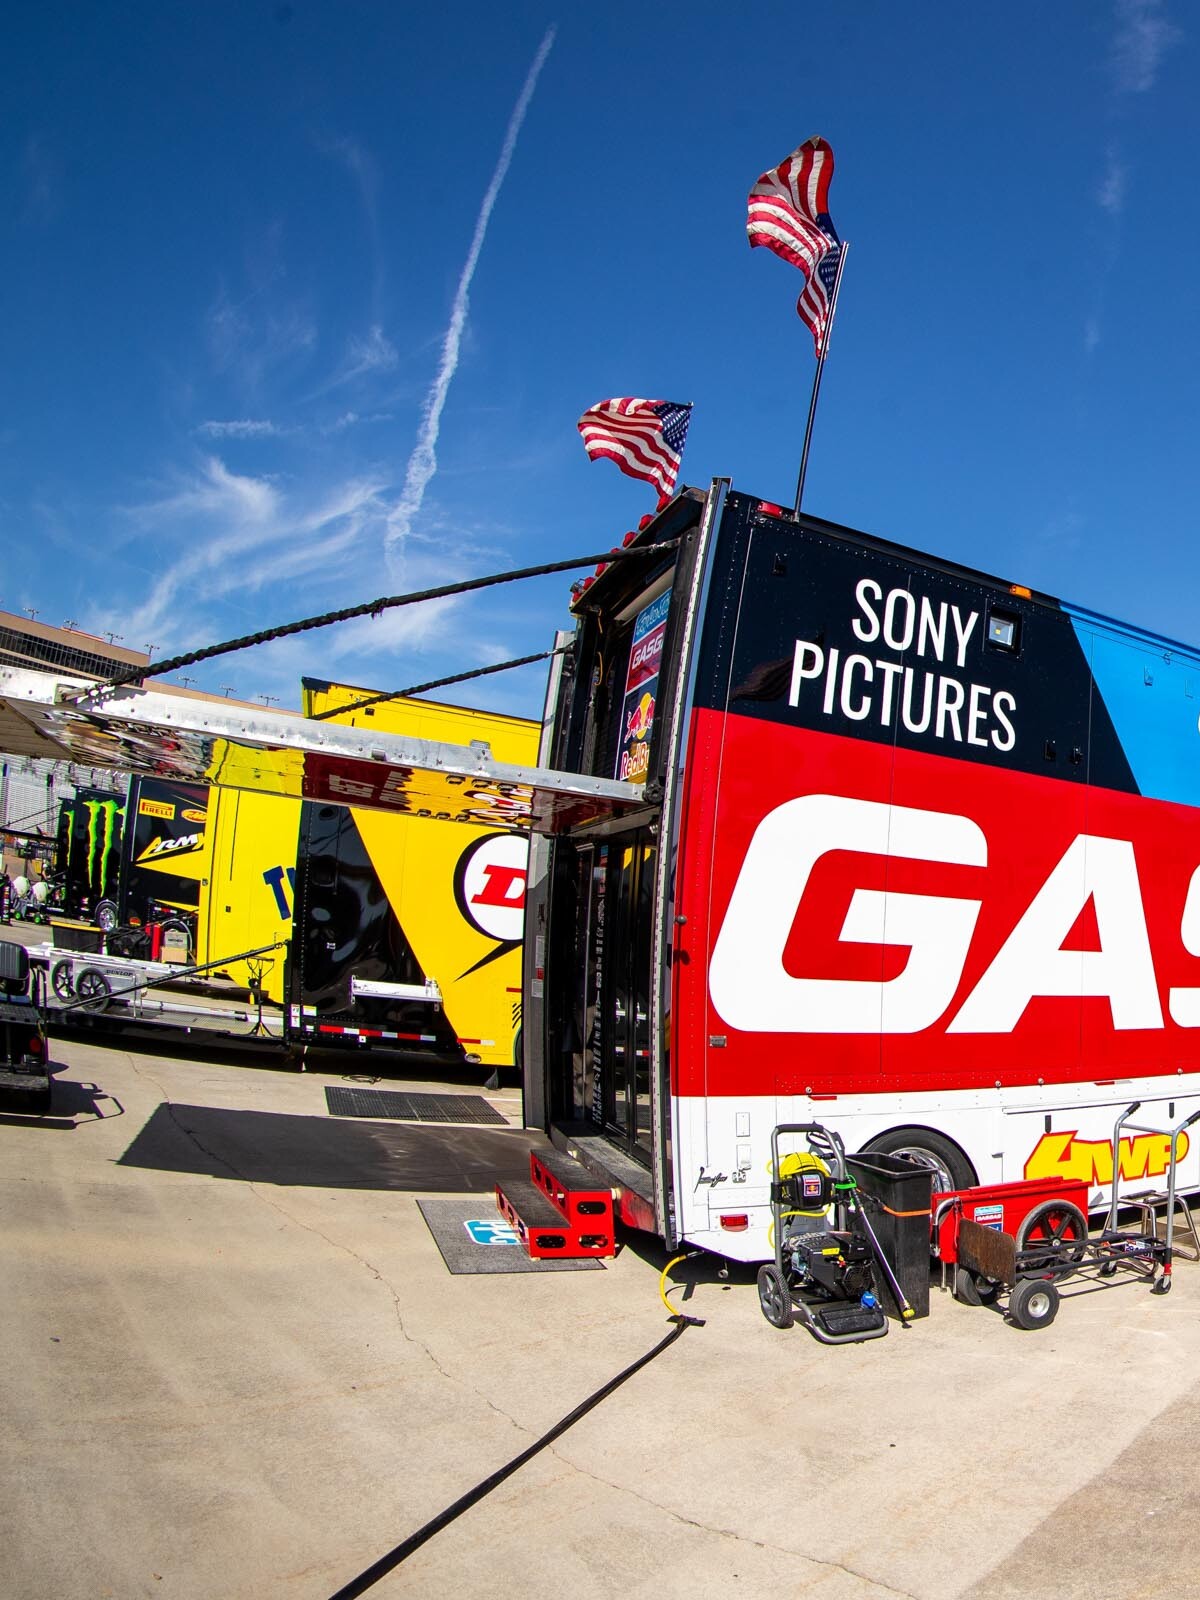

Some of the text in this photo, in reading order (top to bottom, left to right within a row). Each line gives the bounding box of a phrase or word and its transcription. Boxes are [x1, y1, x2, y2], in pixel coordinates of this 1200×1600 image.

[852, 578, 979, 667] SONY
[788, 640, 1017, 752] PICTURES
[142, 802, 173, 817] PIRELLI
[136, 832, 206, 861] ARMY
[106, 968, 134, 977] DUNLOP
